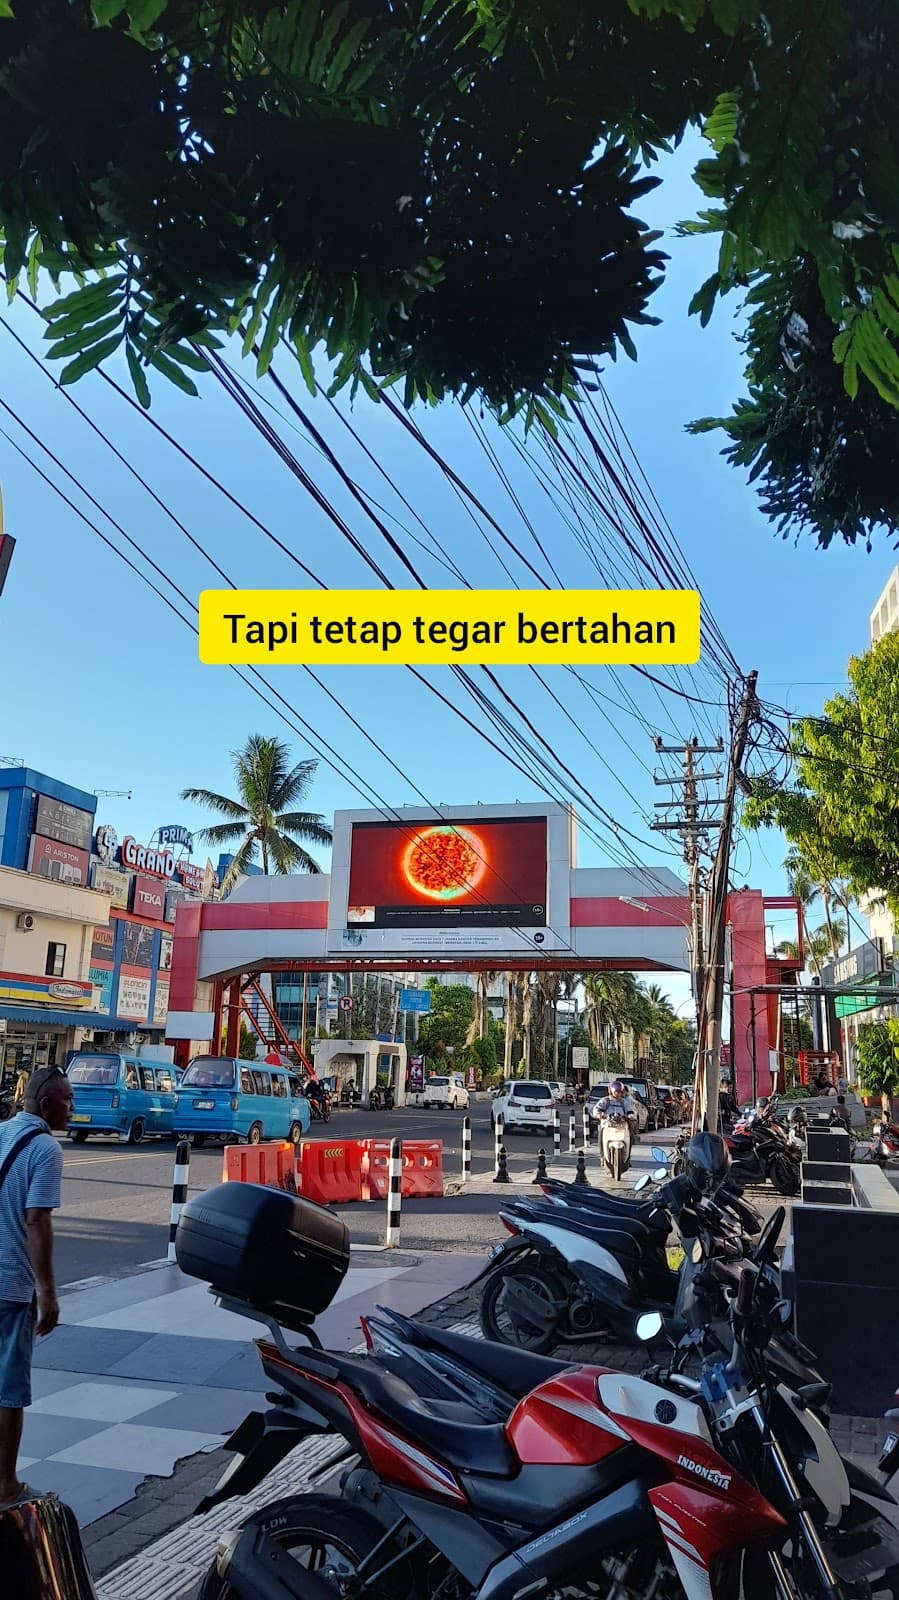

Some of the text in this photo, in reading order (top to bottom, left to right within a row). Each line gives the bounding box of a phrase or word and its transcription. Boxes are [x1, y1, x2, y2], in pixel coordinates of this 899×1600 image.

[161, 828, 194, 852] PRIMA
[53, 848, 79, 863] ARISTON
[125, 838, 176, 878] GRAND
[138, 890, 162, 907] TEKA
[676, 1454, 730, 1491] INDONESIA
